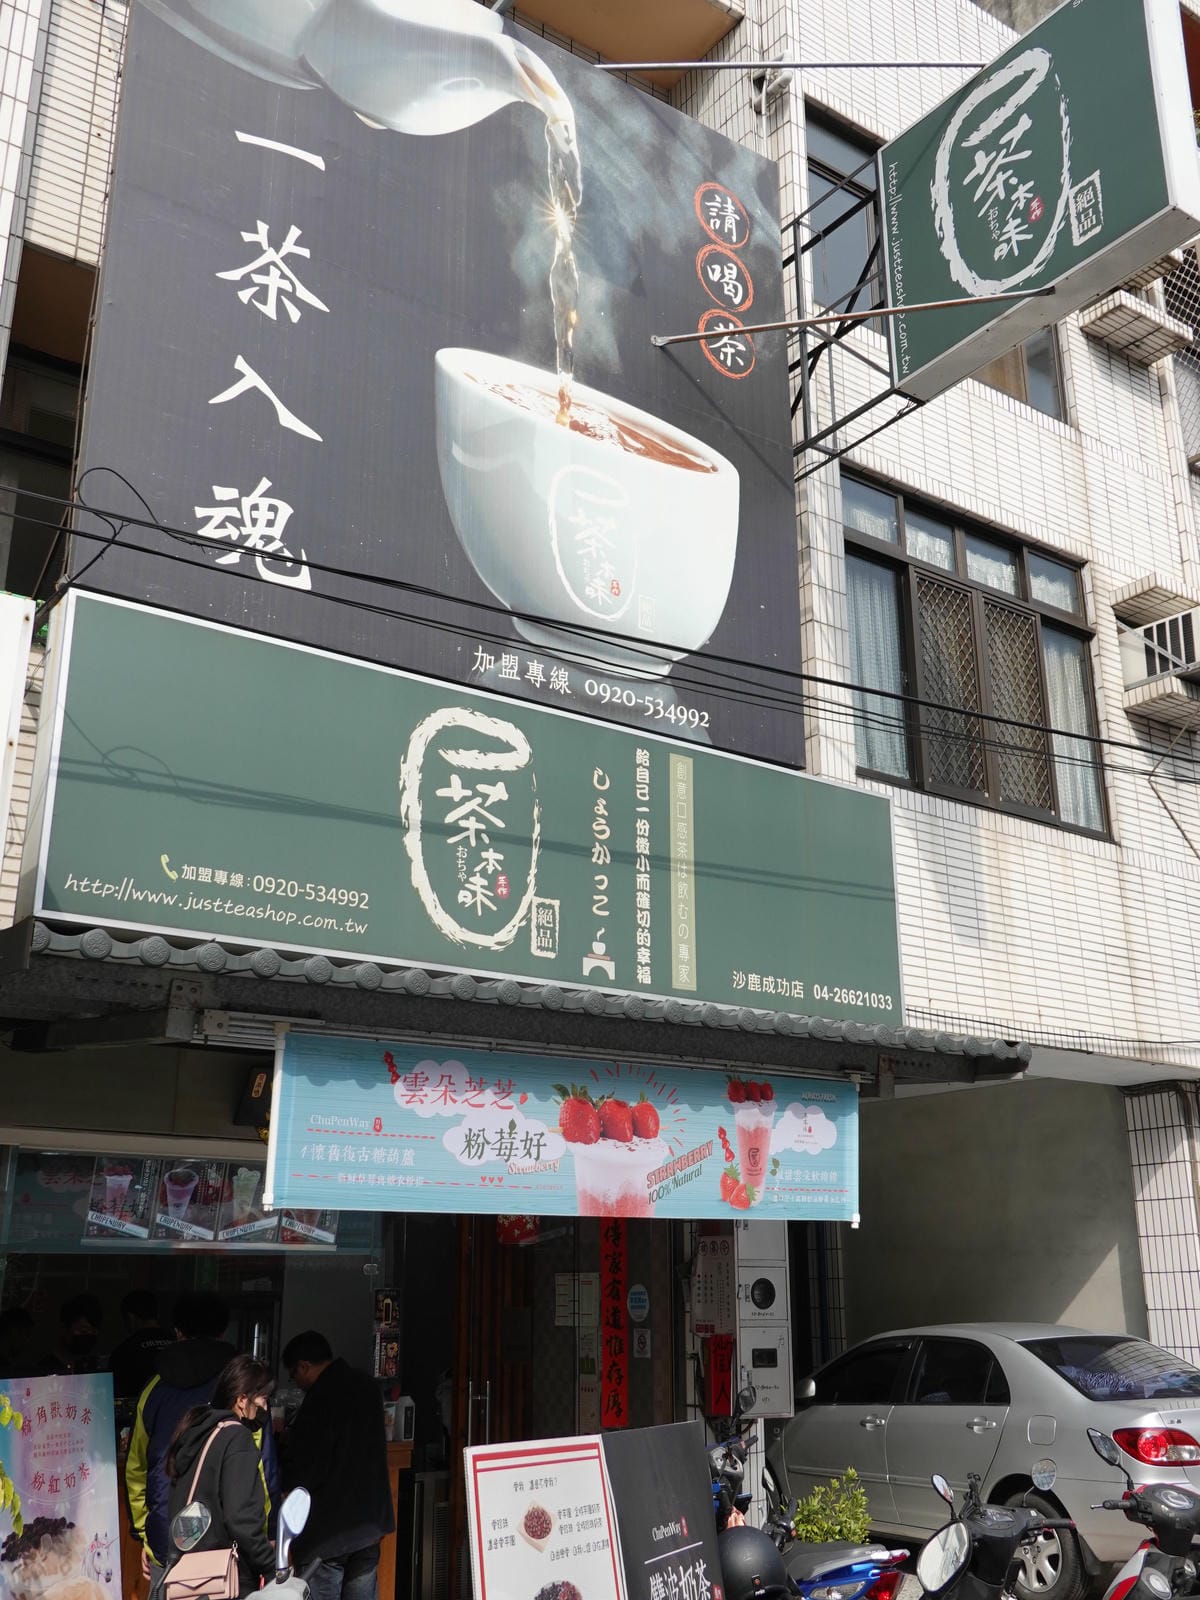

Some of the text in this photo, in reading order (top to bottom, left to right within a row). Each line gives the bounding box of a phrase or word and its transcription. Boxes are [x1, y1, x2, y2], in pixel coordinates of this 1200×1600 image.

[1074, 184, 1097, 234] 絕品
[194, 129, 331, 590] 一茶入魂
[471, 644, 711, 729] 加盟專線 0920-534992
[456, 845, 468, 882] おちゃ
[635, 747, 652, 985] 給自己一份微小而確切的幸福
[64, 873, 369, 935] http://www.justteashop.com.tw
[536, 907, 554, 948] 絕品
[732, 970, 893, 1011] 沙鹿成功店 04-26621033
[400, 1070, 518, 1110] 雲朵芝芝
[459, 1124, 548, 1163] 粉莓好
[646, 1139, 714, 1189] STRAWBERRY
[673, 1164, 703, 1189] Natural
